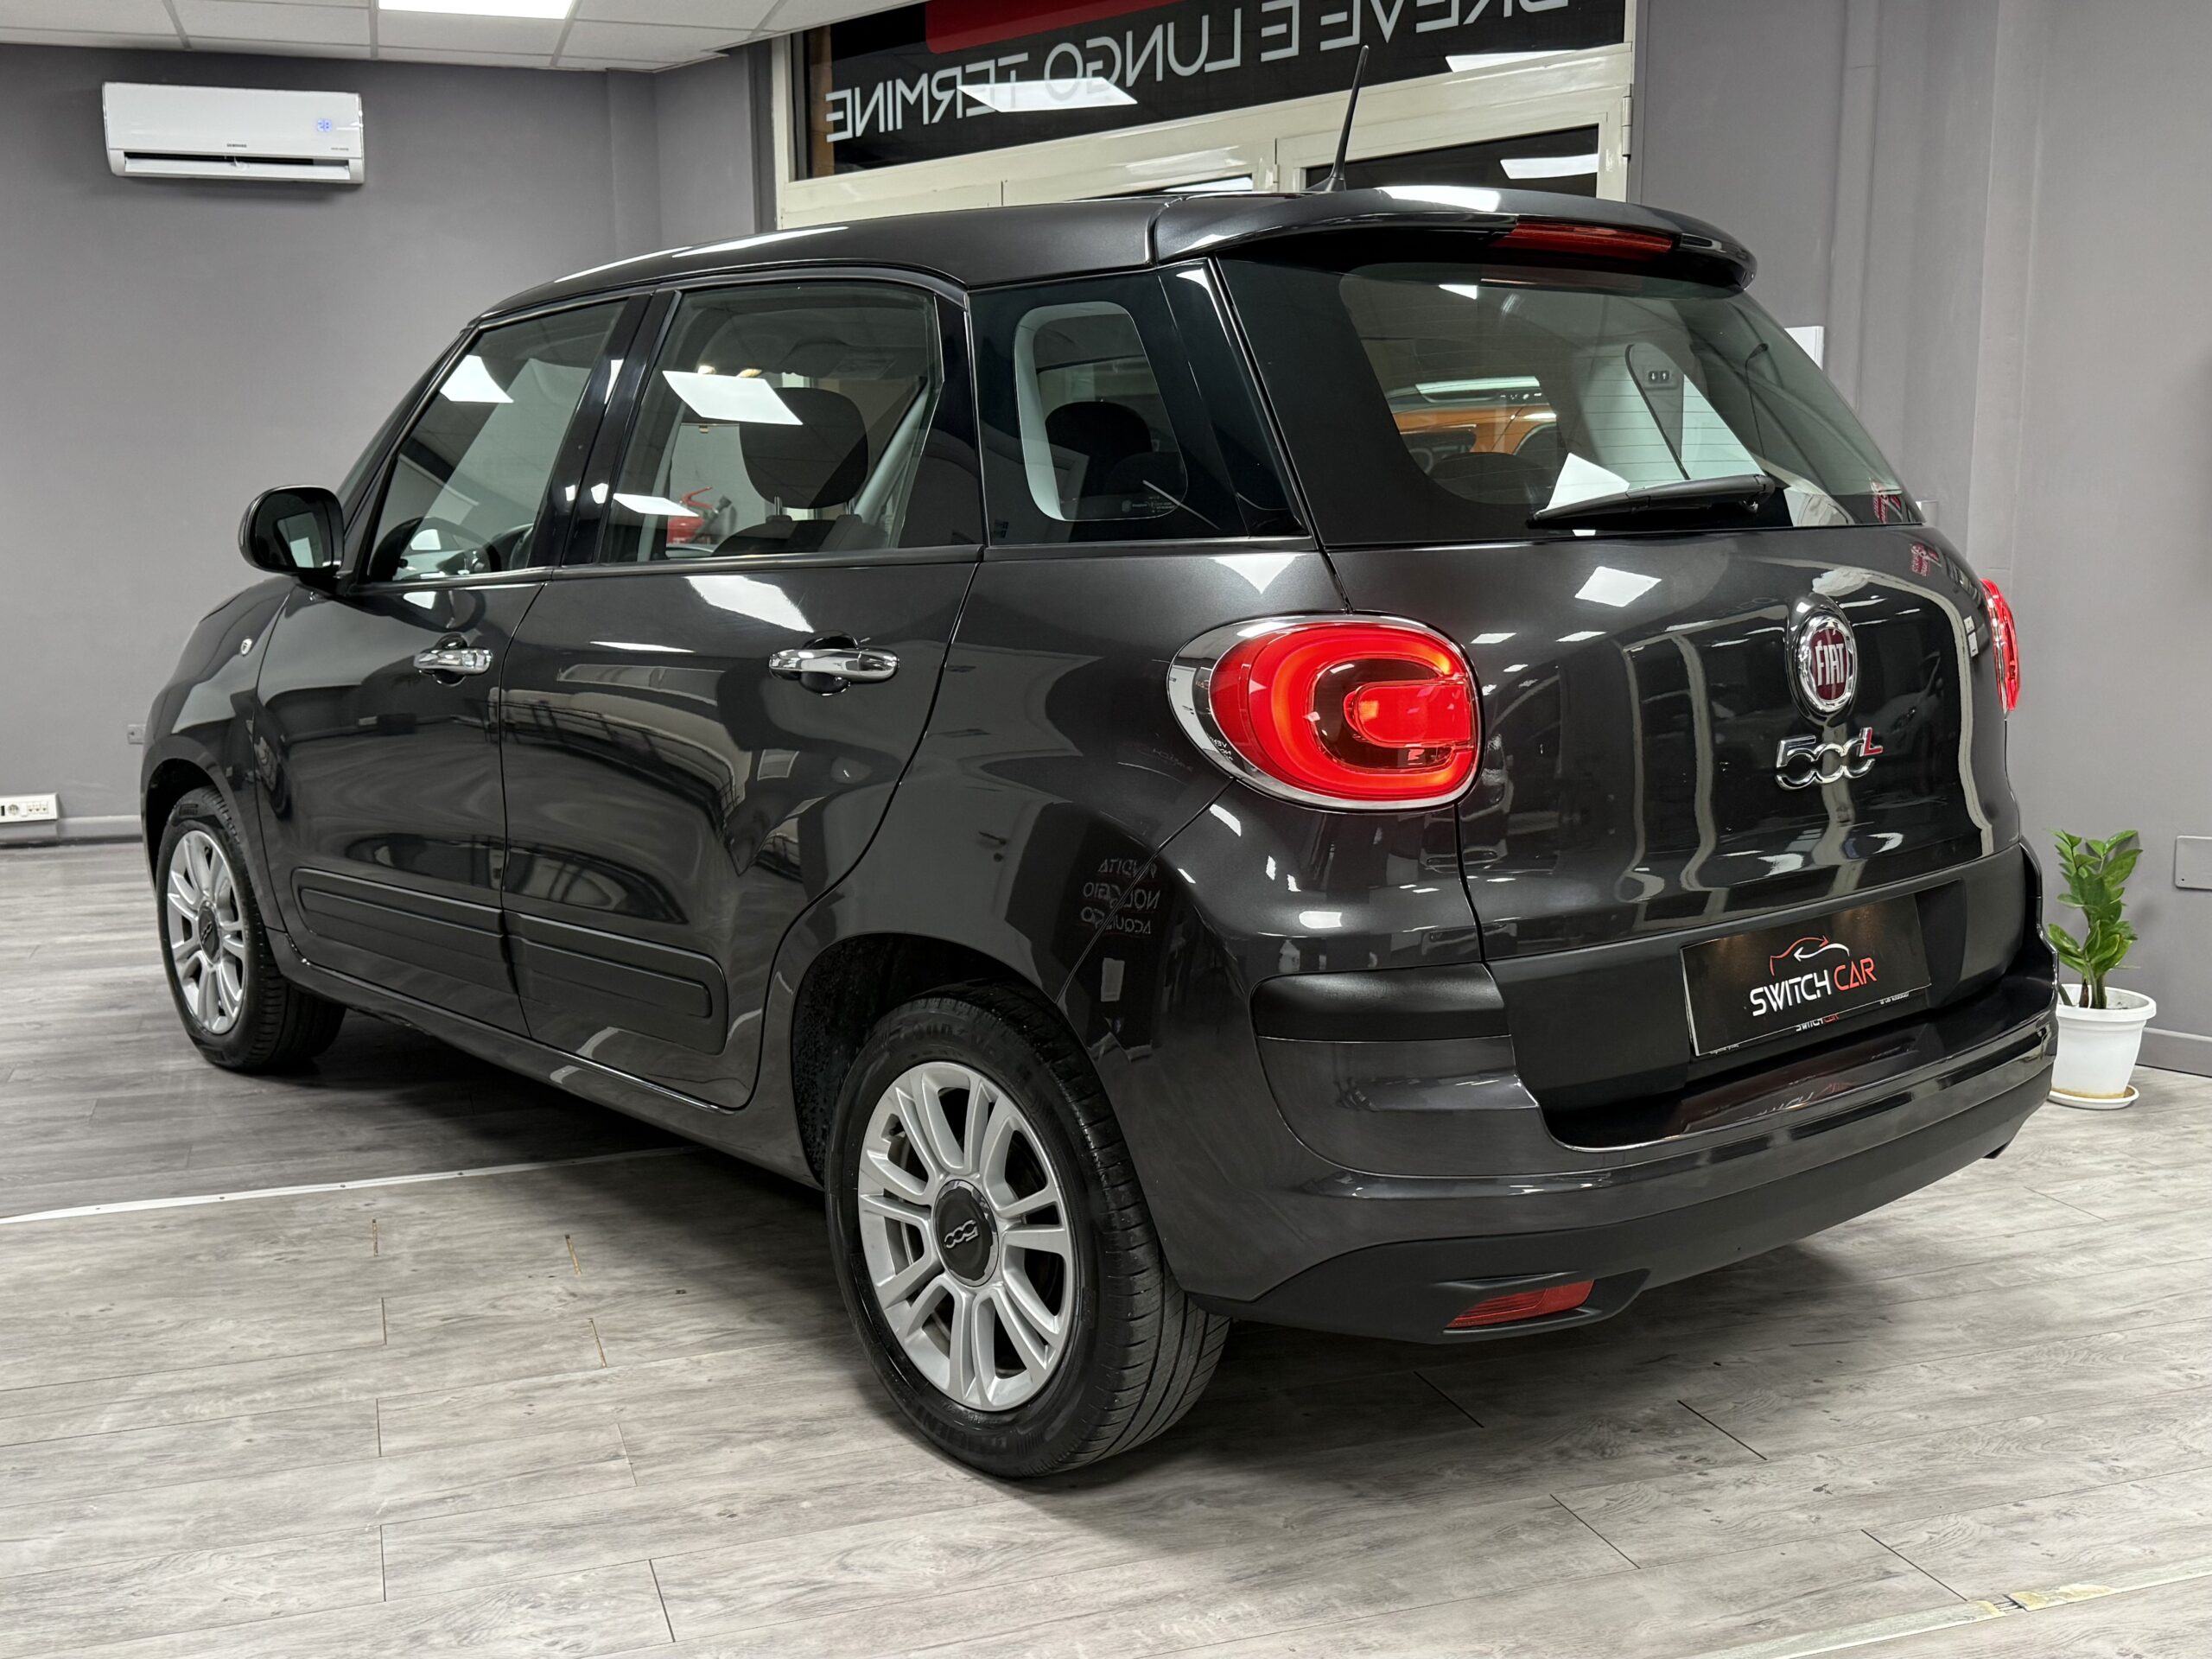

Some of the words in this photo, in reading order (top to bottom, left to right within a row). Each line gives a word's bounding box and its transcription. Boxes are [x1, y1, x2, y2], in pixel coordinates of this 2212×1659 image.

[1815, 643, 1844, 686] FIAT
[1750, 969, 1831, 1016] SWITCH
[1834, 957, 1878, 991] CAR
[944, 1219, 978, 1249] 500
